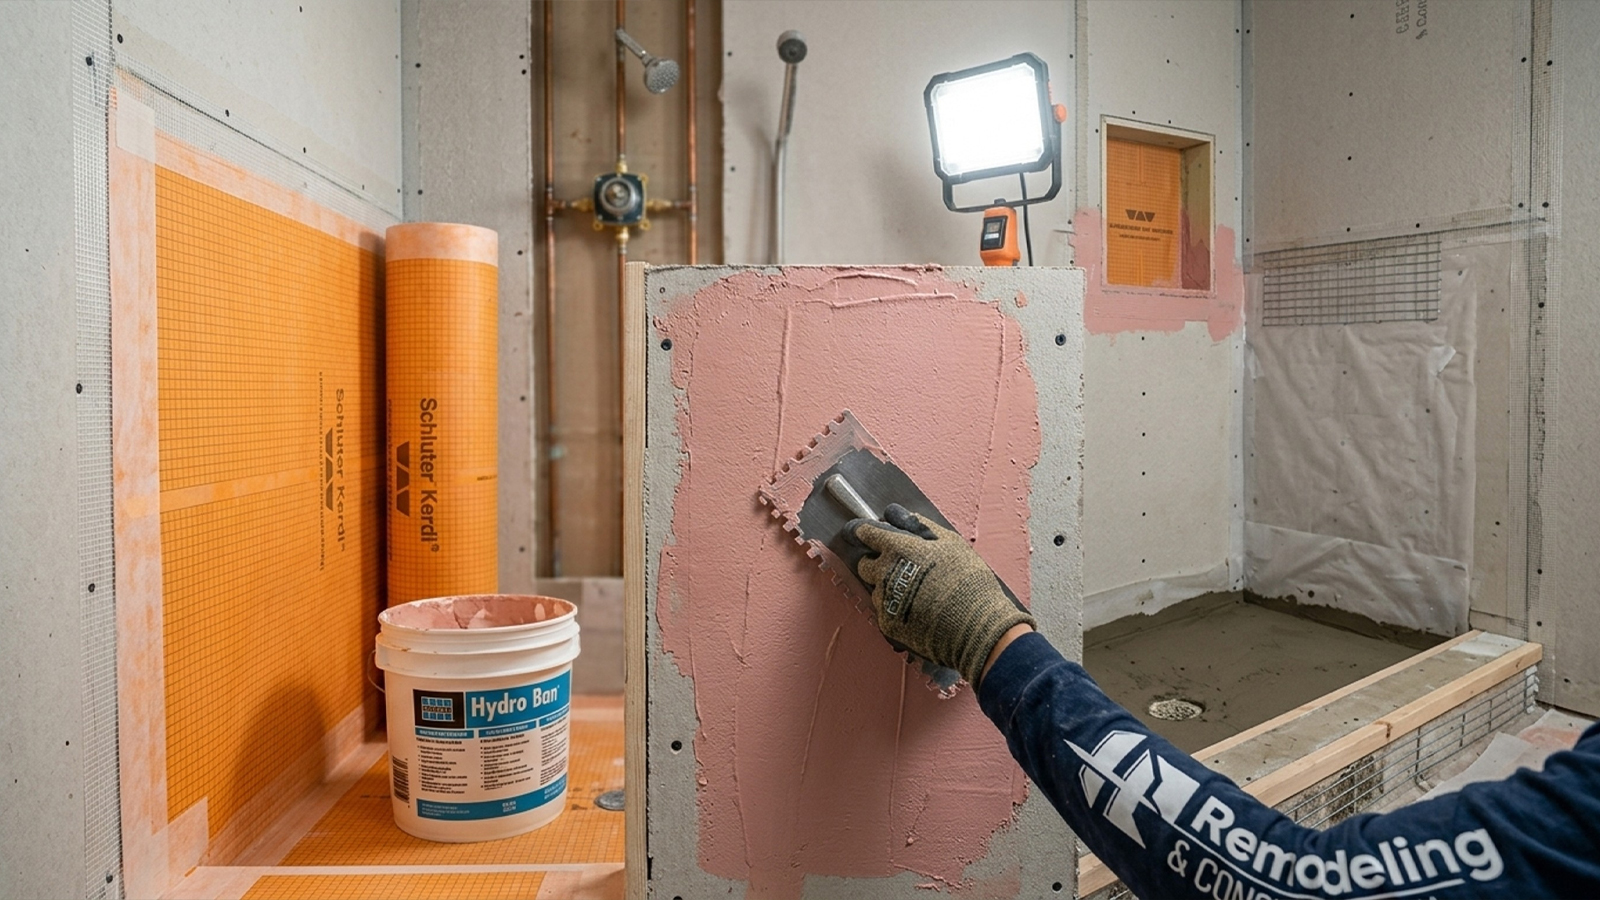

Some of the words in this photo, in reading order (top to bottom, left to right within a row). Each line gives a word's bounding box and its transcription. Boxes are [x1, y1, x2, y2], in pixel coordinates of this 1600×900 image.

[420, 398, 438, 483] Schluter
[471, 692, 528, 722] Hydro
[532, 687, 558, 708] Ban
[1167, 839, 1191, 877] &
[1190, 795, 1505, 896] Remodeling
